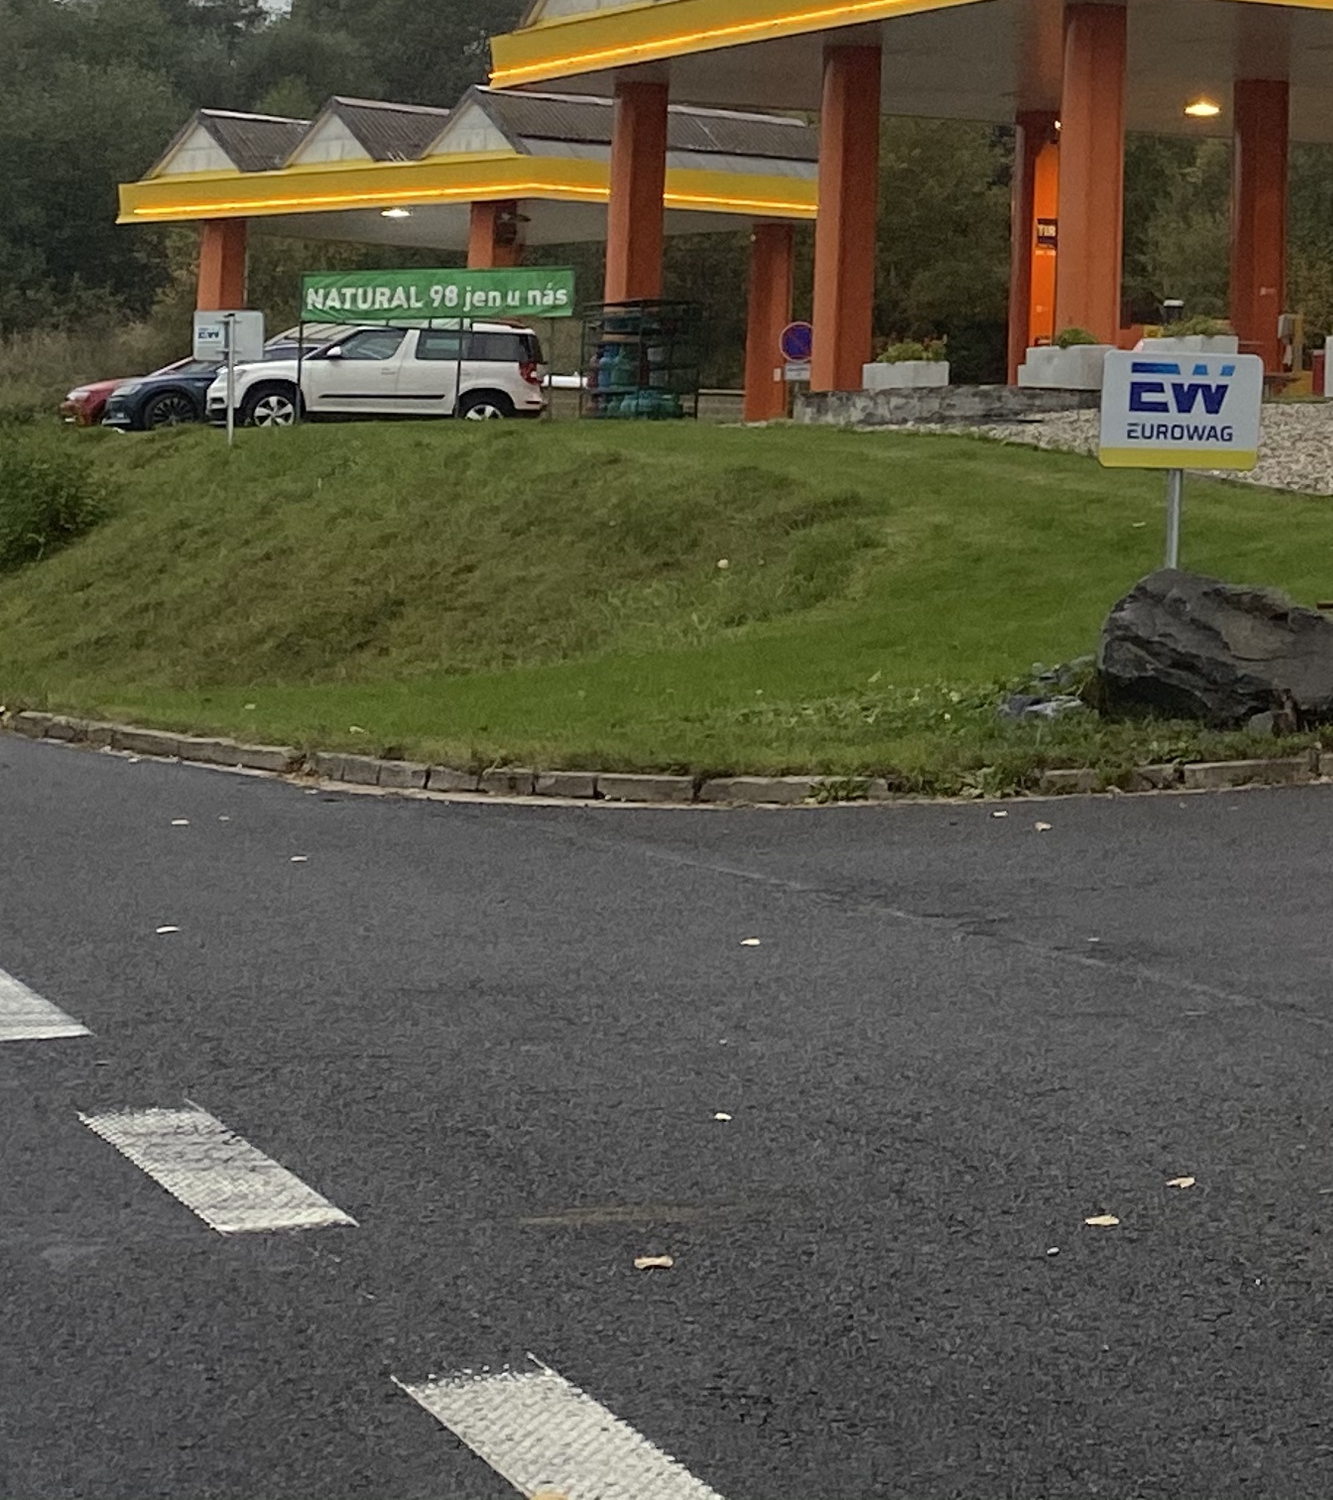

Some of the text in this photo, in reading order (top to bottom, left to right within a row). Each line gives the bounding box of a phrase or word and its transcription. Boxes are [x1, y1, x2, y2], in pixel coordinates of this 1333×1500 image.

[306, 282, 568, 312] NATURAL 98 jen u nás
[1129, 362, 1235, 414] EW
[1127, 422, 1233, 442] EUROWAG
